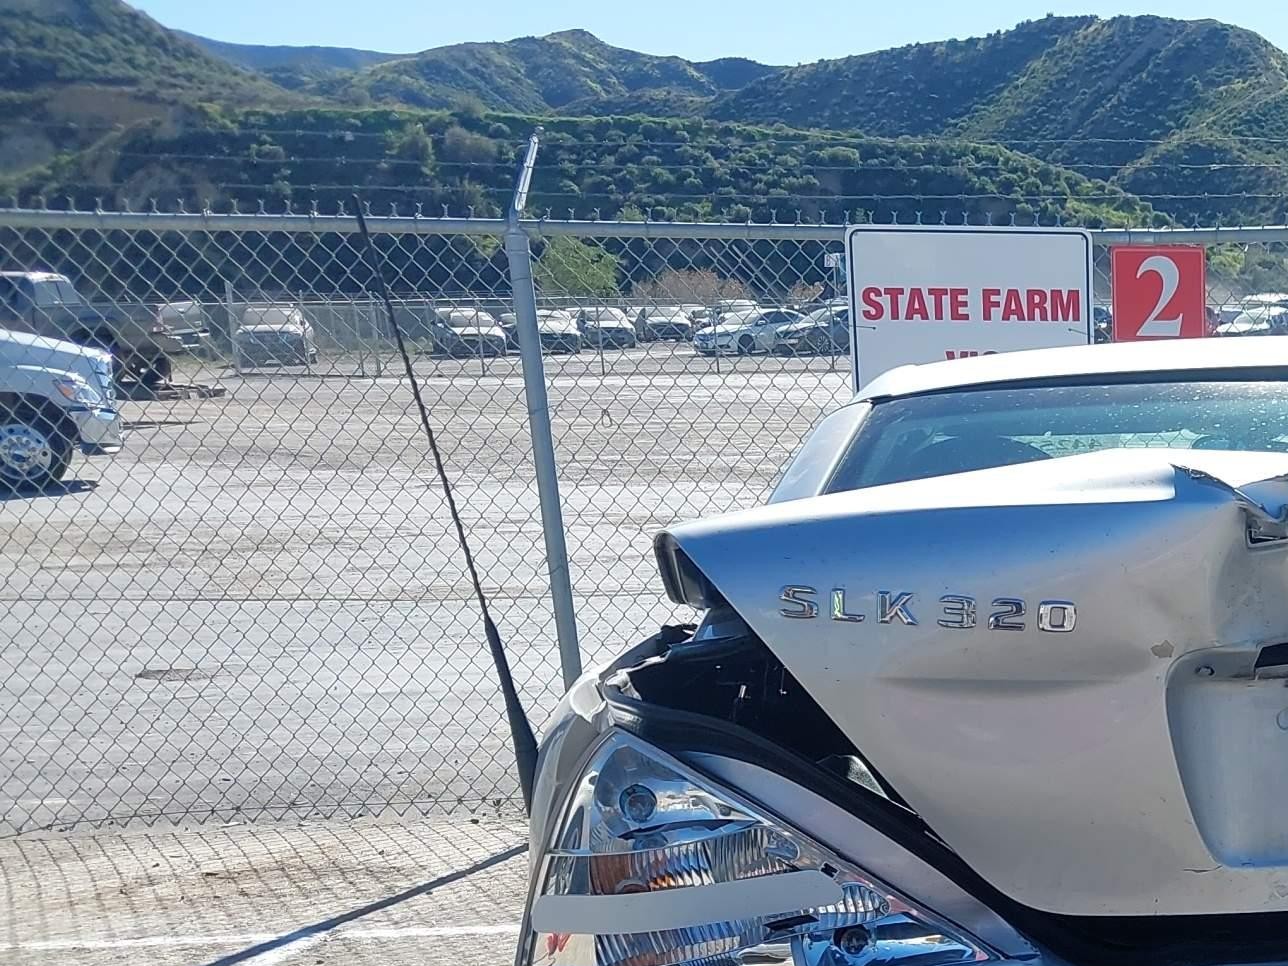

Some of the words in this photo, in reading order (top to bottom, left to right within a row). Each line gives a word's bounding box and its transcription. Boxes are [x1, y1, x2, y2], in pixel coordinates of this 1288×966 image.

[862, 286, 970, 322] STATE
[982, 288, 1080, 322] FARM
[1135, 255, 1184, 337] 2
[779, 584, 919, 626] SLK
[937, 594, 1078, 632] 320
